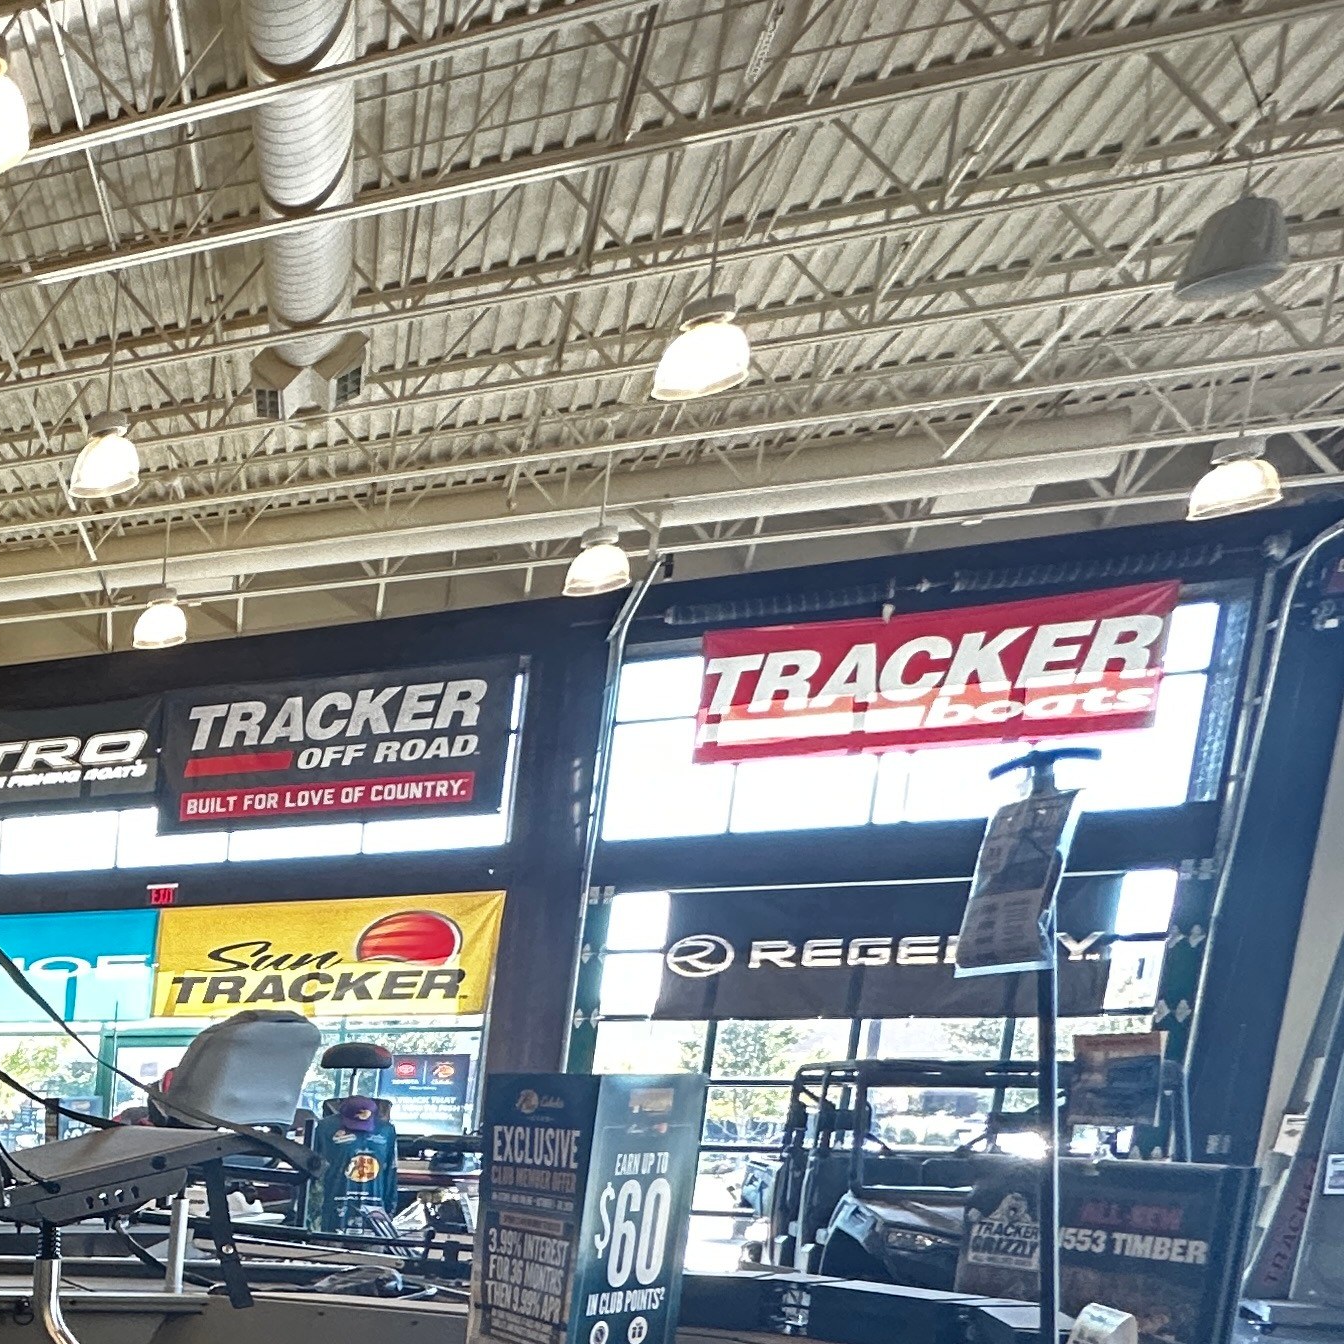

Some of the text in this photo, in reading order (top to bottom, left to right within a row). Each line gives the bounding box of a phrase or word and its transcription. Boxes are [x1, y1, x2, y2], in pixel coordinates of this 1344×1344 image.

[706, 614, 1164, 716] TRACKER
[189, 678, 489, 751] TRACKER
[920, 685, 1155, 727] boats
[296, 734, 479, 770] OFF ROAD
[186, 777, 469, 816] BUILT FOR LOVE OF COUNTRY.
[191, 941, 349, 973] Sun
[748, 931, 1102, 970] REGEY
[172, 968, 468, 1005] TRACKER
[492, 1125, 580, 1170] EXCLUSIVE
[615, 1151, 670, 1176] EARN UP TO
[523, 1233, 570, 1267] INTEREST
[594, 1177, 672, 1288] $60
[1111, 1231, 1209, 1265] TIMBER
[586, 1293, 598, 1316] IN
[598, 1290, 623, 1315] CLUB
